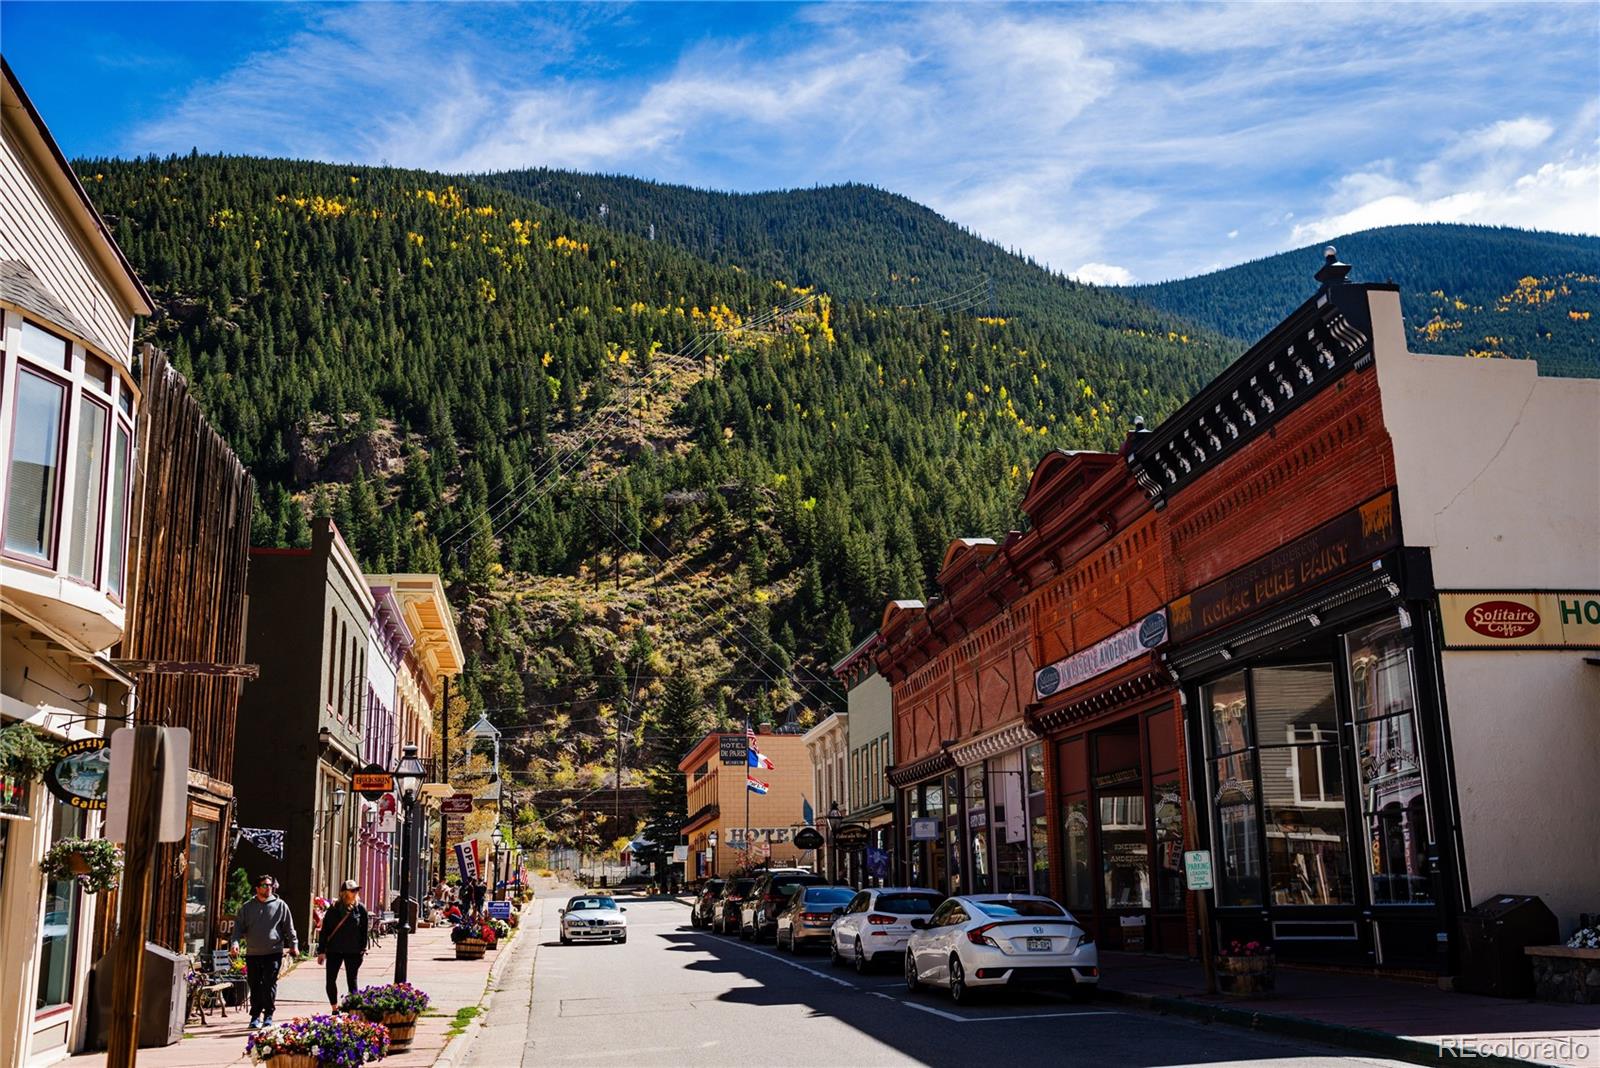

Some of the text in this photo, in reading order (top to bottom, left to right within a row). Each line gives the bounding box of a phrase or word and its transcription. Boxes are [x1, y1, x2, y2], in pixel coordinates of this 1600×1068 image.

[1473, 608, 1535, 627] Solitaire
[1488, 621, 1526, 637] Coffee
[1100, 632, 1139, 663] ANDERSON
[59, 739, 105, 757] Grizzly
[356, 776, 391, 784] BUCKSKIN
[71, 796, 107, 809] Galle
[463, 846, 477, 879] OPEN
[1192, 853, 1203, 862] NO
